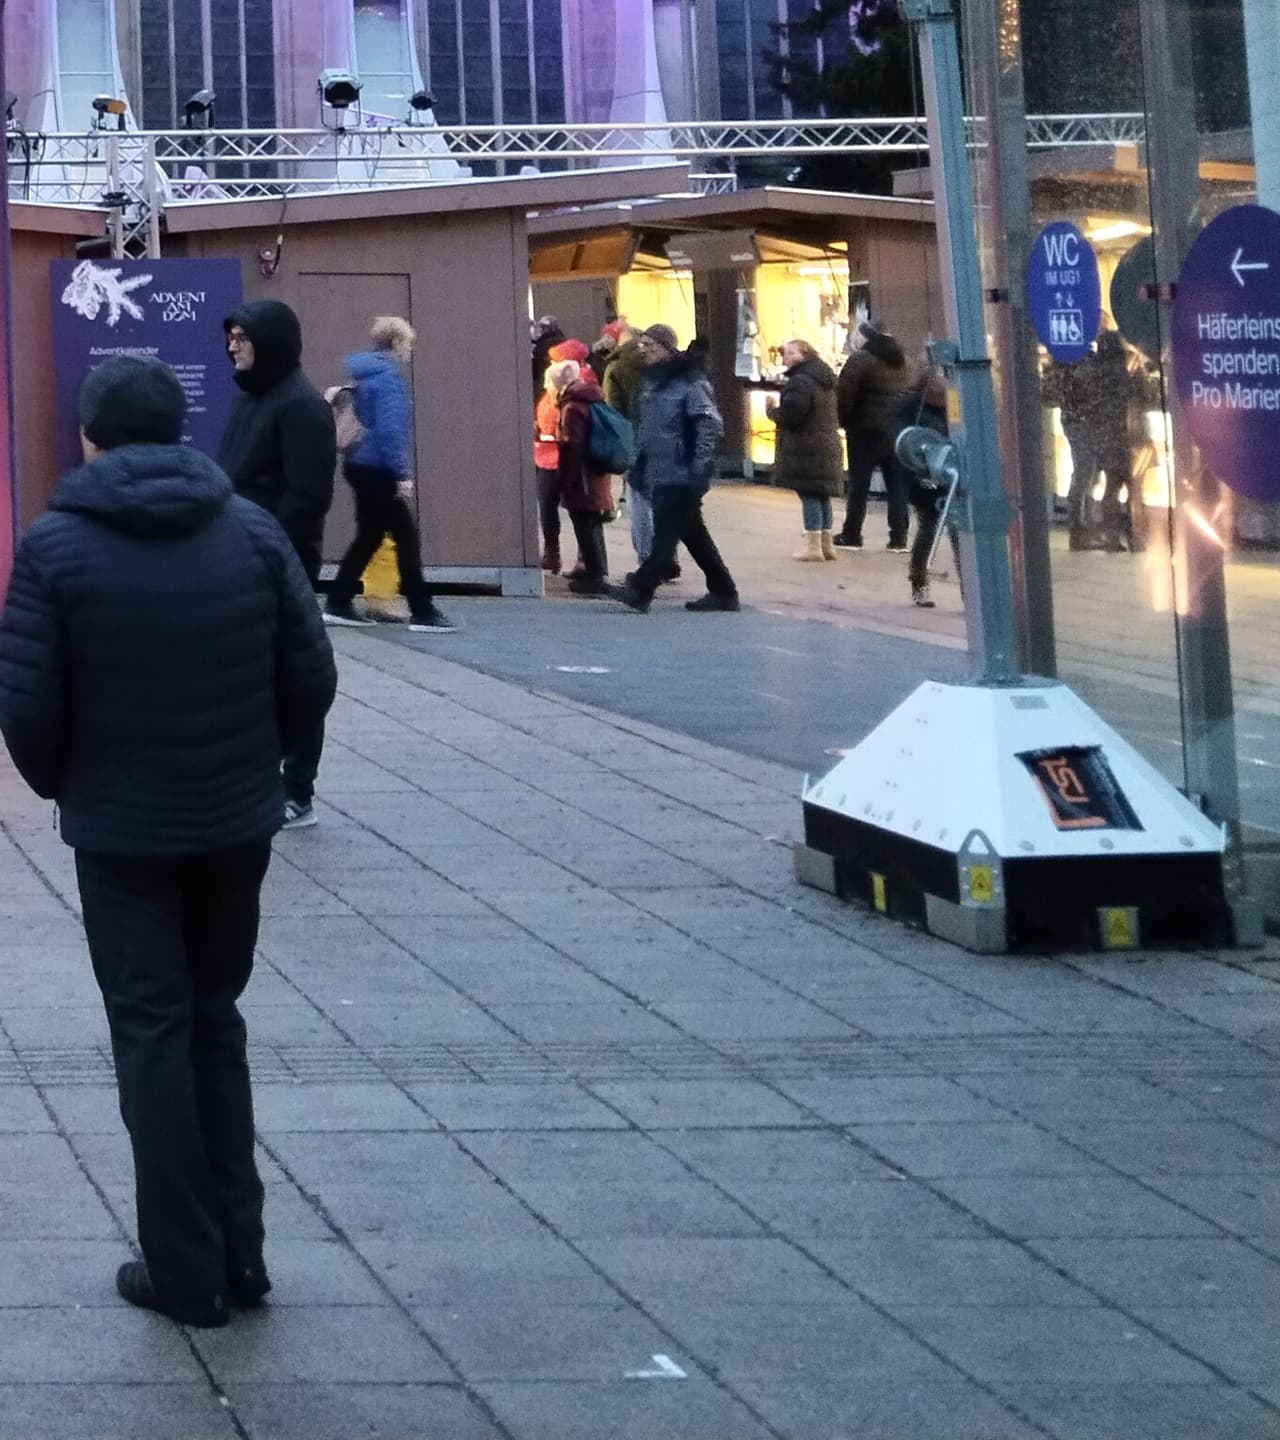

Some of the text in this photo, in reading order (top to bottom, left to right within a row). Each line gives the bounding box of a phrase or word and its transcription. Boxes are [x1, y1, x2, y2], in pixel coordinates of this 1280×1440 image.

[1043, 233, 1079, 266] WC
[149, 292, 207, 303] ADVENT
[167, 302, 191, 312] AM
[163, 311, 196, 322] DOM
[90, 346, 159, 357] Adventkalender
[1203, 347, 1280, 378] spenden
[1192, 381, 1220, 408] Pro
